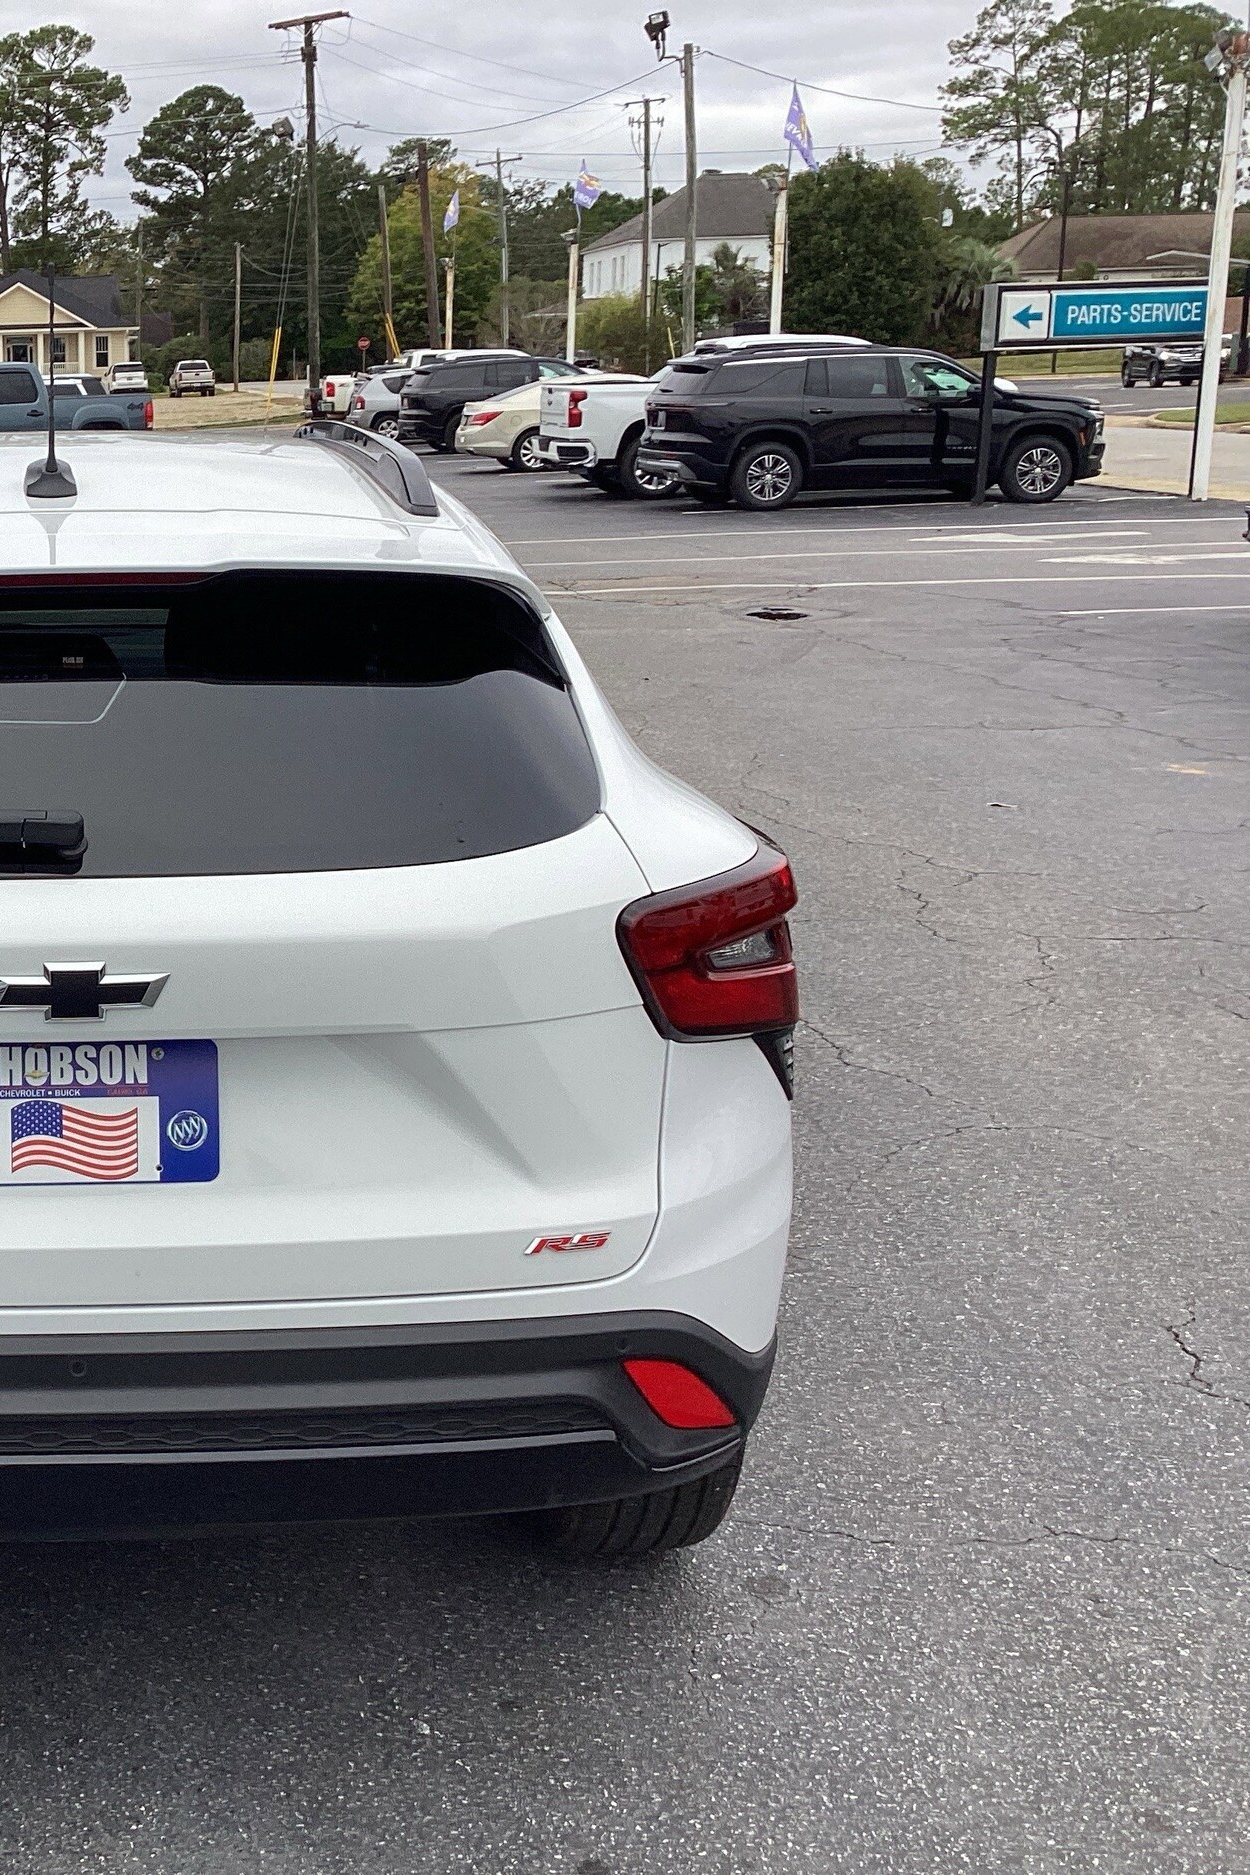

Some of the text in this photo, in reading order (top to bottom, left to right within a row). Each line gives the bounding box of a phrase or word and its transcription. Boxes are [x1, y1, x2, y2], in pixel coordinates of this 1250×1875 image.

[1066, 301, 1203, 325] PARTS-SERVICE
[0, 1088, 81, 1097] CHEVROLET BUICK
[524, 1230, 611, 1255] RS
